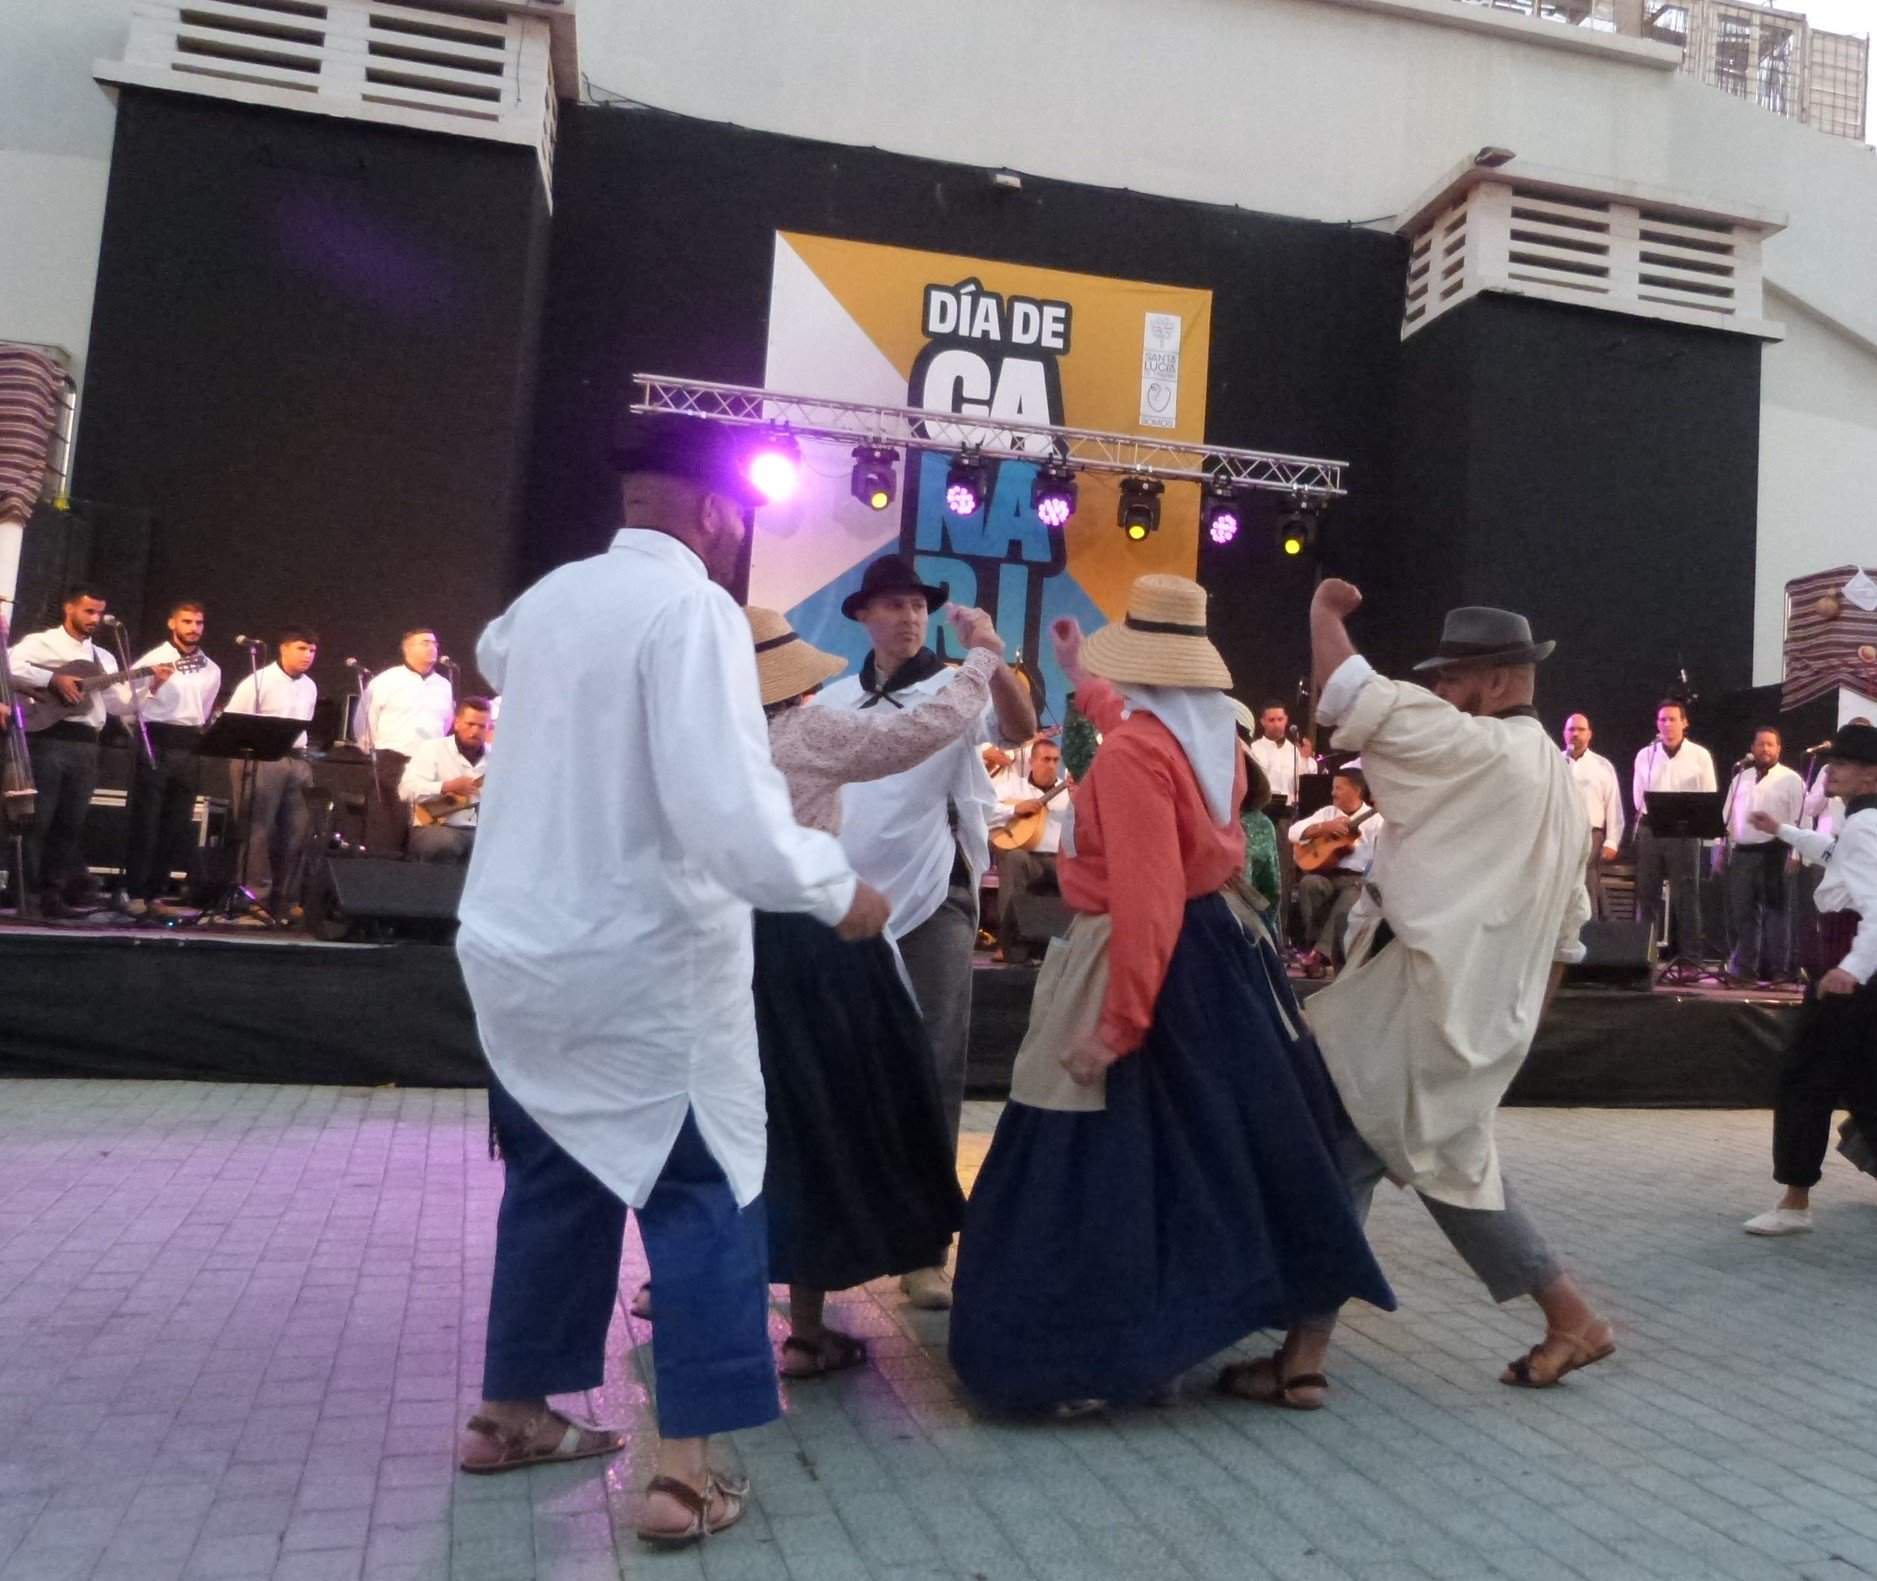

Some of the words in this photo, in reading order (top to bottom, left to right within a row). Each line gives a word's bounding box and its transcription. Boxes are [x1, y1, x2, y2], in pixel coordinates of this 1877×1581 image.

[928, 283, 1001, 341] DÍA
[1011, 301, 1067, 350] DE
[922, 349, 1054, 457] CA
[915, 451, 1052, 562] NA
